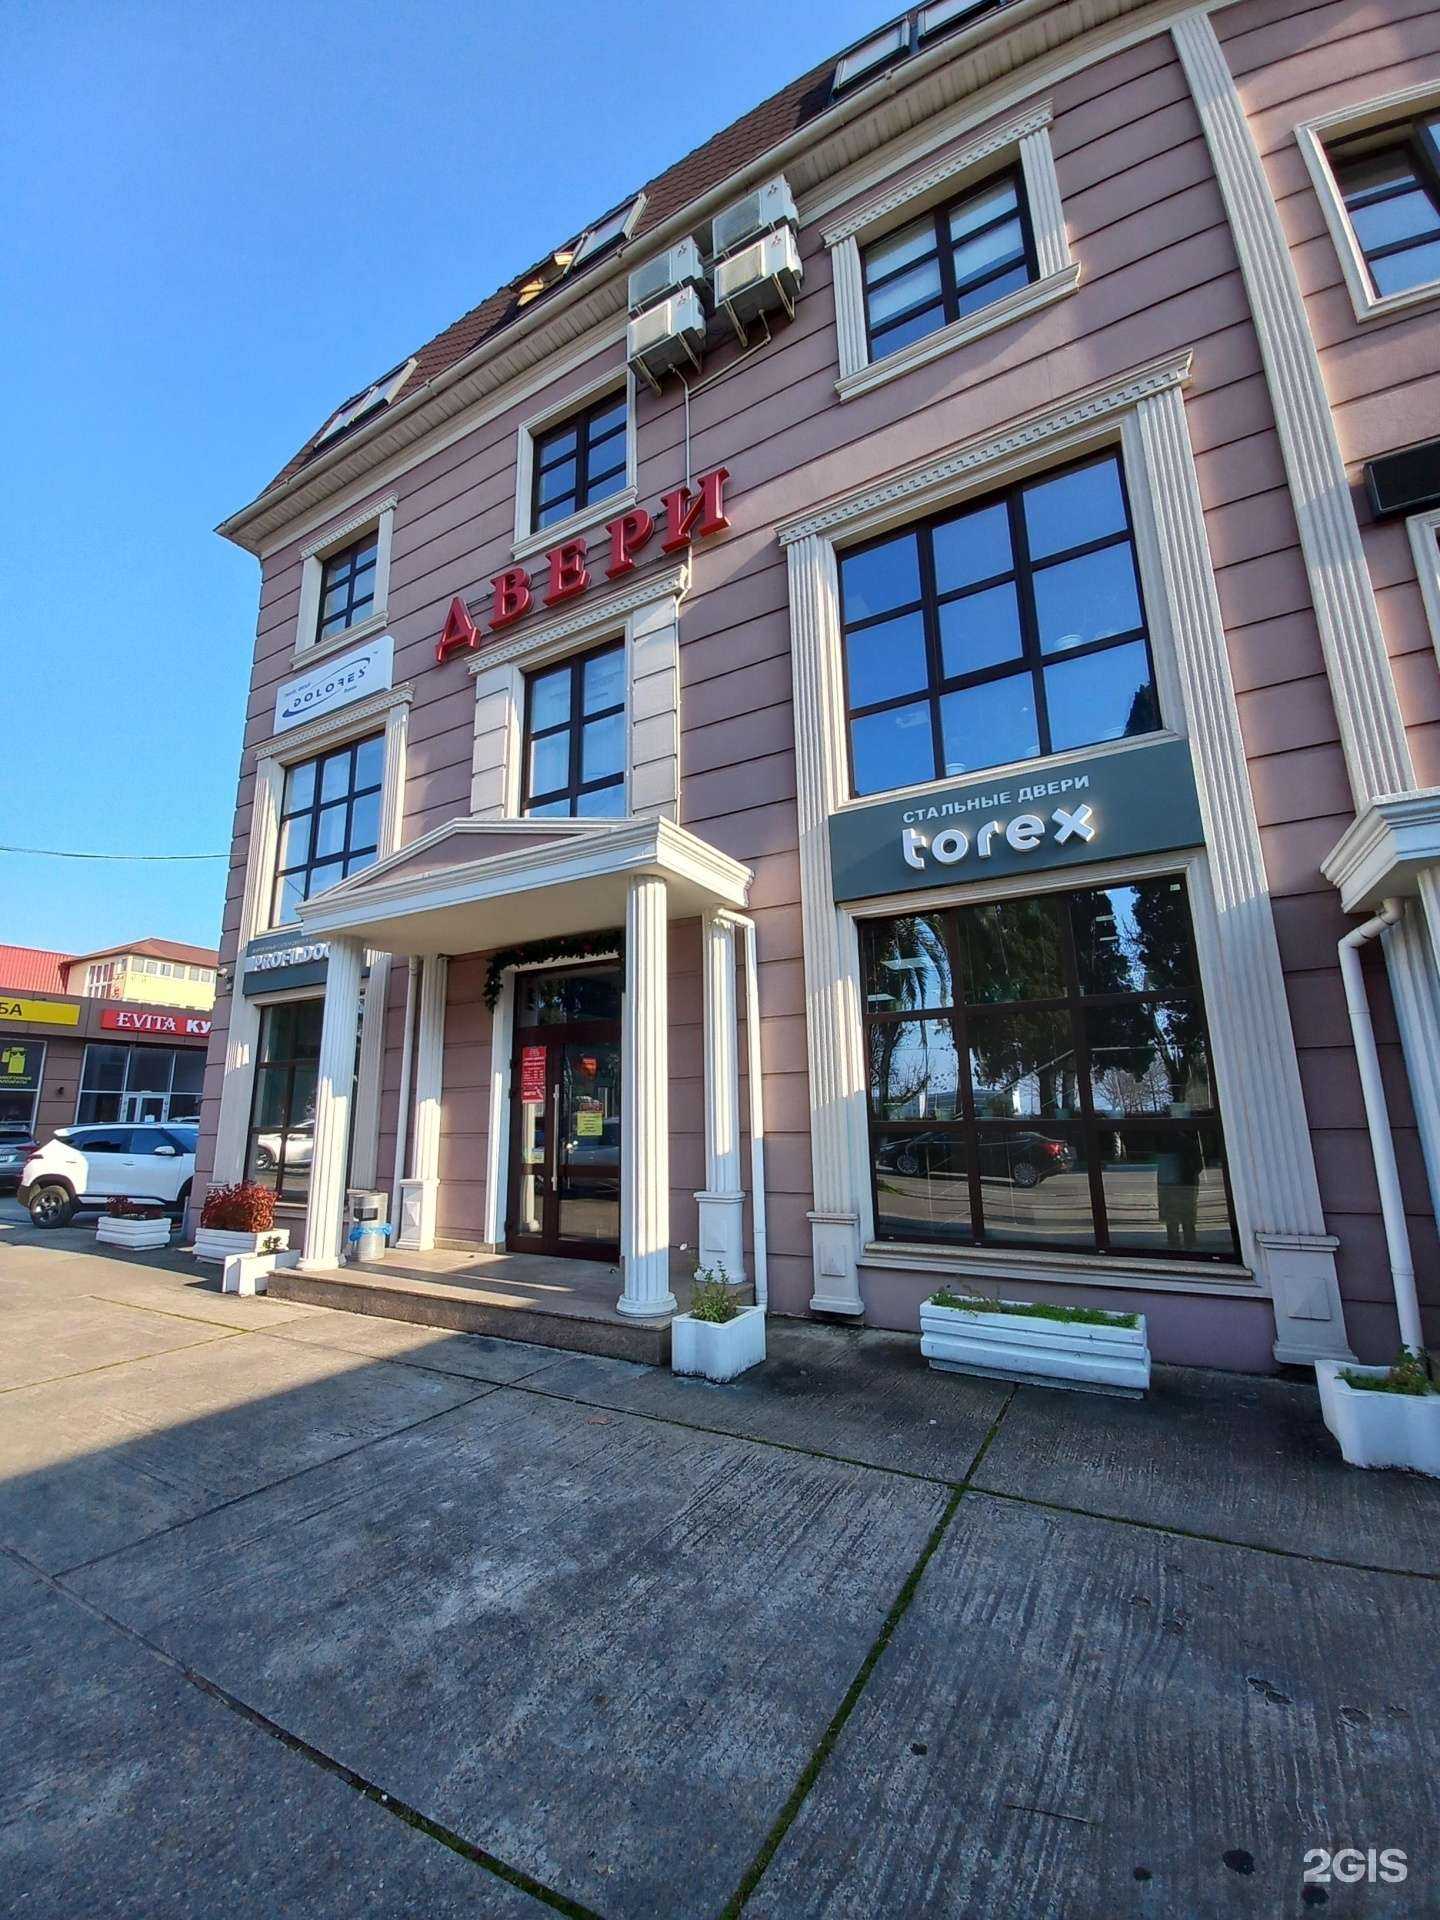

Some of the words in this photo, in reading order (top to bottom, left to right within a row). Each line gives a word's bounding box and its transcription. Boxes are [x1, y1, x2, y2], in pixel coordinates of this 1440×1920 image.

[435, 466, 731, 663] ДВЕРИ
[293, 665, 367, 708] DOLORES
[903, 791, 1011, 823] СТАЛЬНЫЕ
[1017, 775, 1090, 803] ДВЕРИ
[902, 803, 1096, 870] torex
[117, 1012, 176, 1031] EVITA
